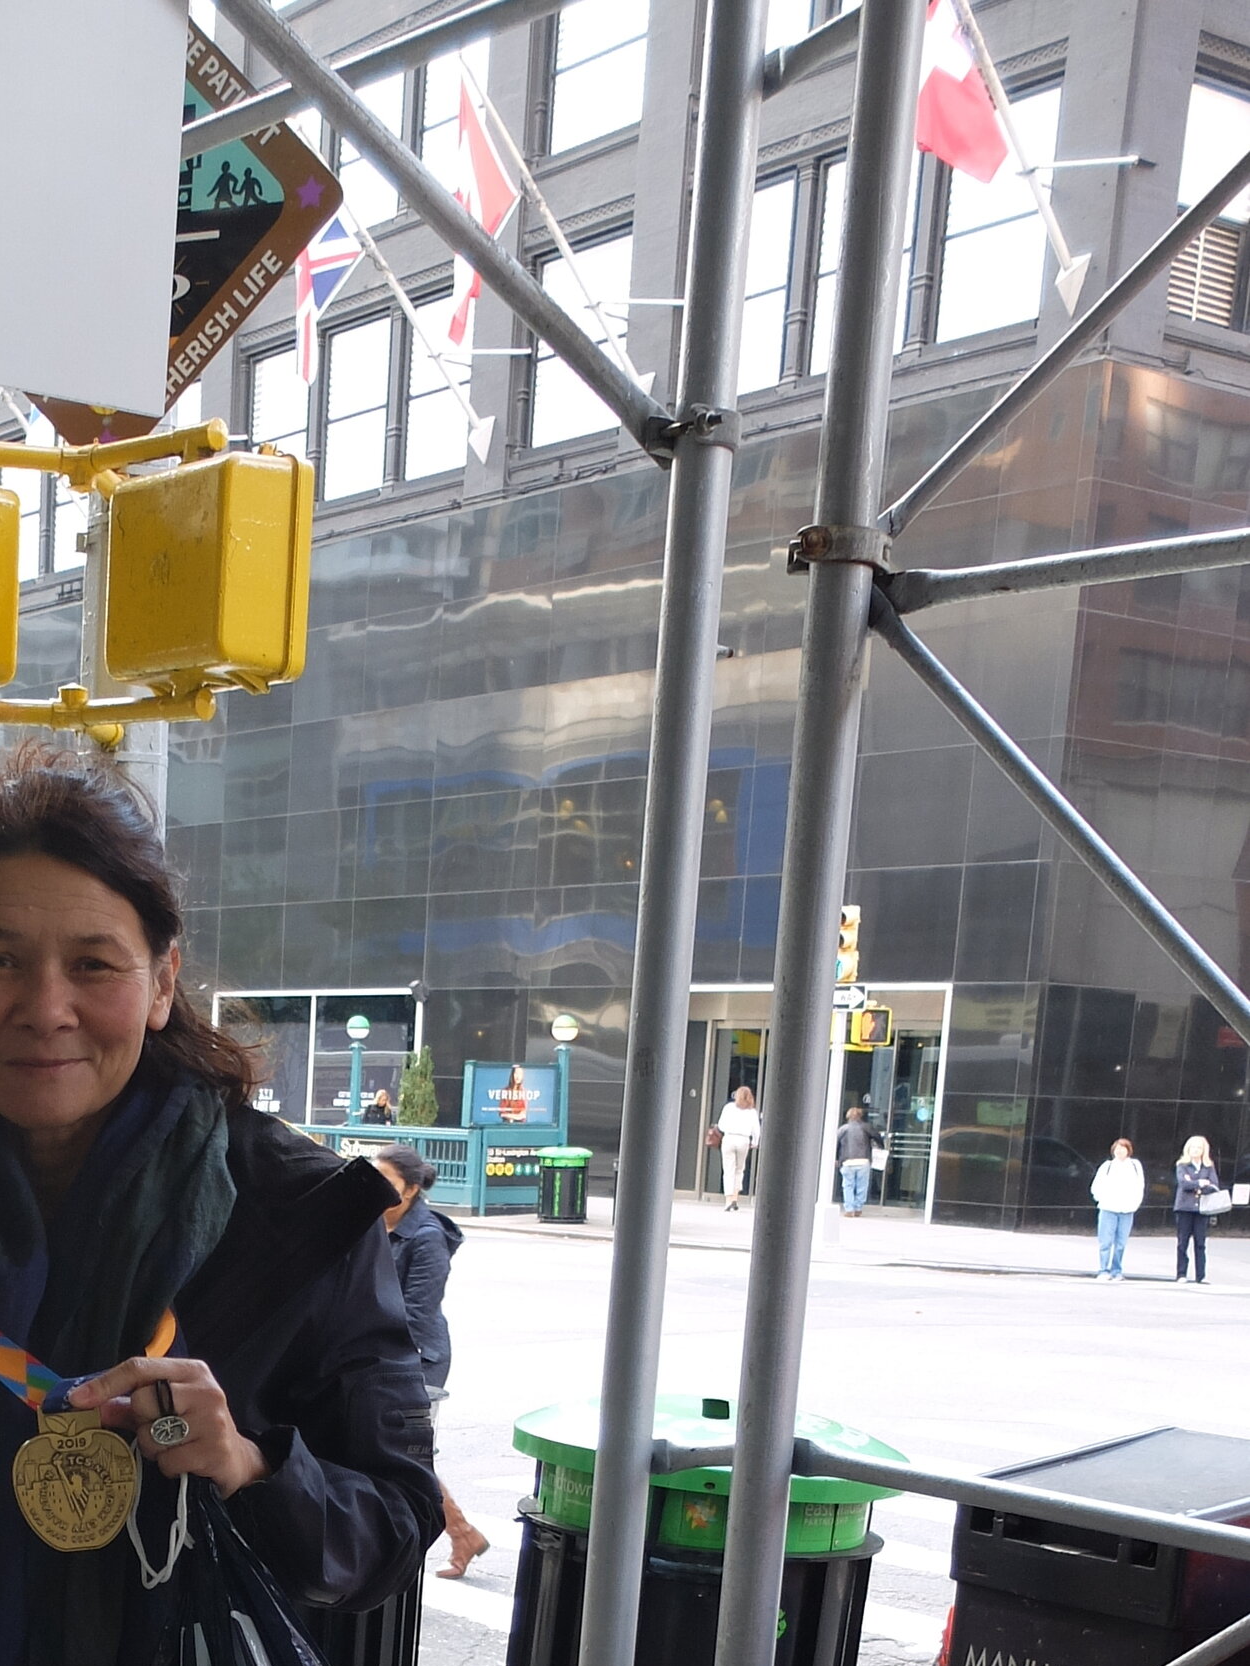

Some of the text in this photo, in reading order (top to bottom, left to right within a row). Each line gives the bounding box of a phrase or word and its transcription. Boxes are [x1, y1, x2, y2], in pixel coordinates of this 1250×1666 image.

[198, 55, 281, 145] PATIT
[165, 249, 283, 401] HERISH LIFE
[488, 1089, 541, 1101] VERISHOP
[340, 1137, 386, 1160] Subwa
[57, 1437, 87, 1450] 2019
[67, 1456, 92, 1467] TCS
